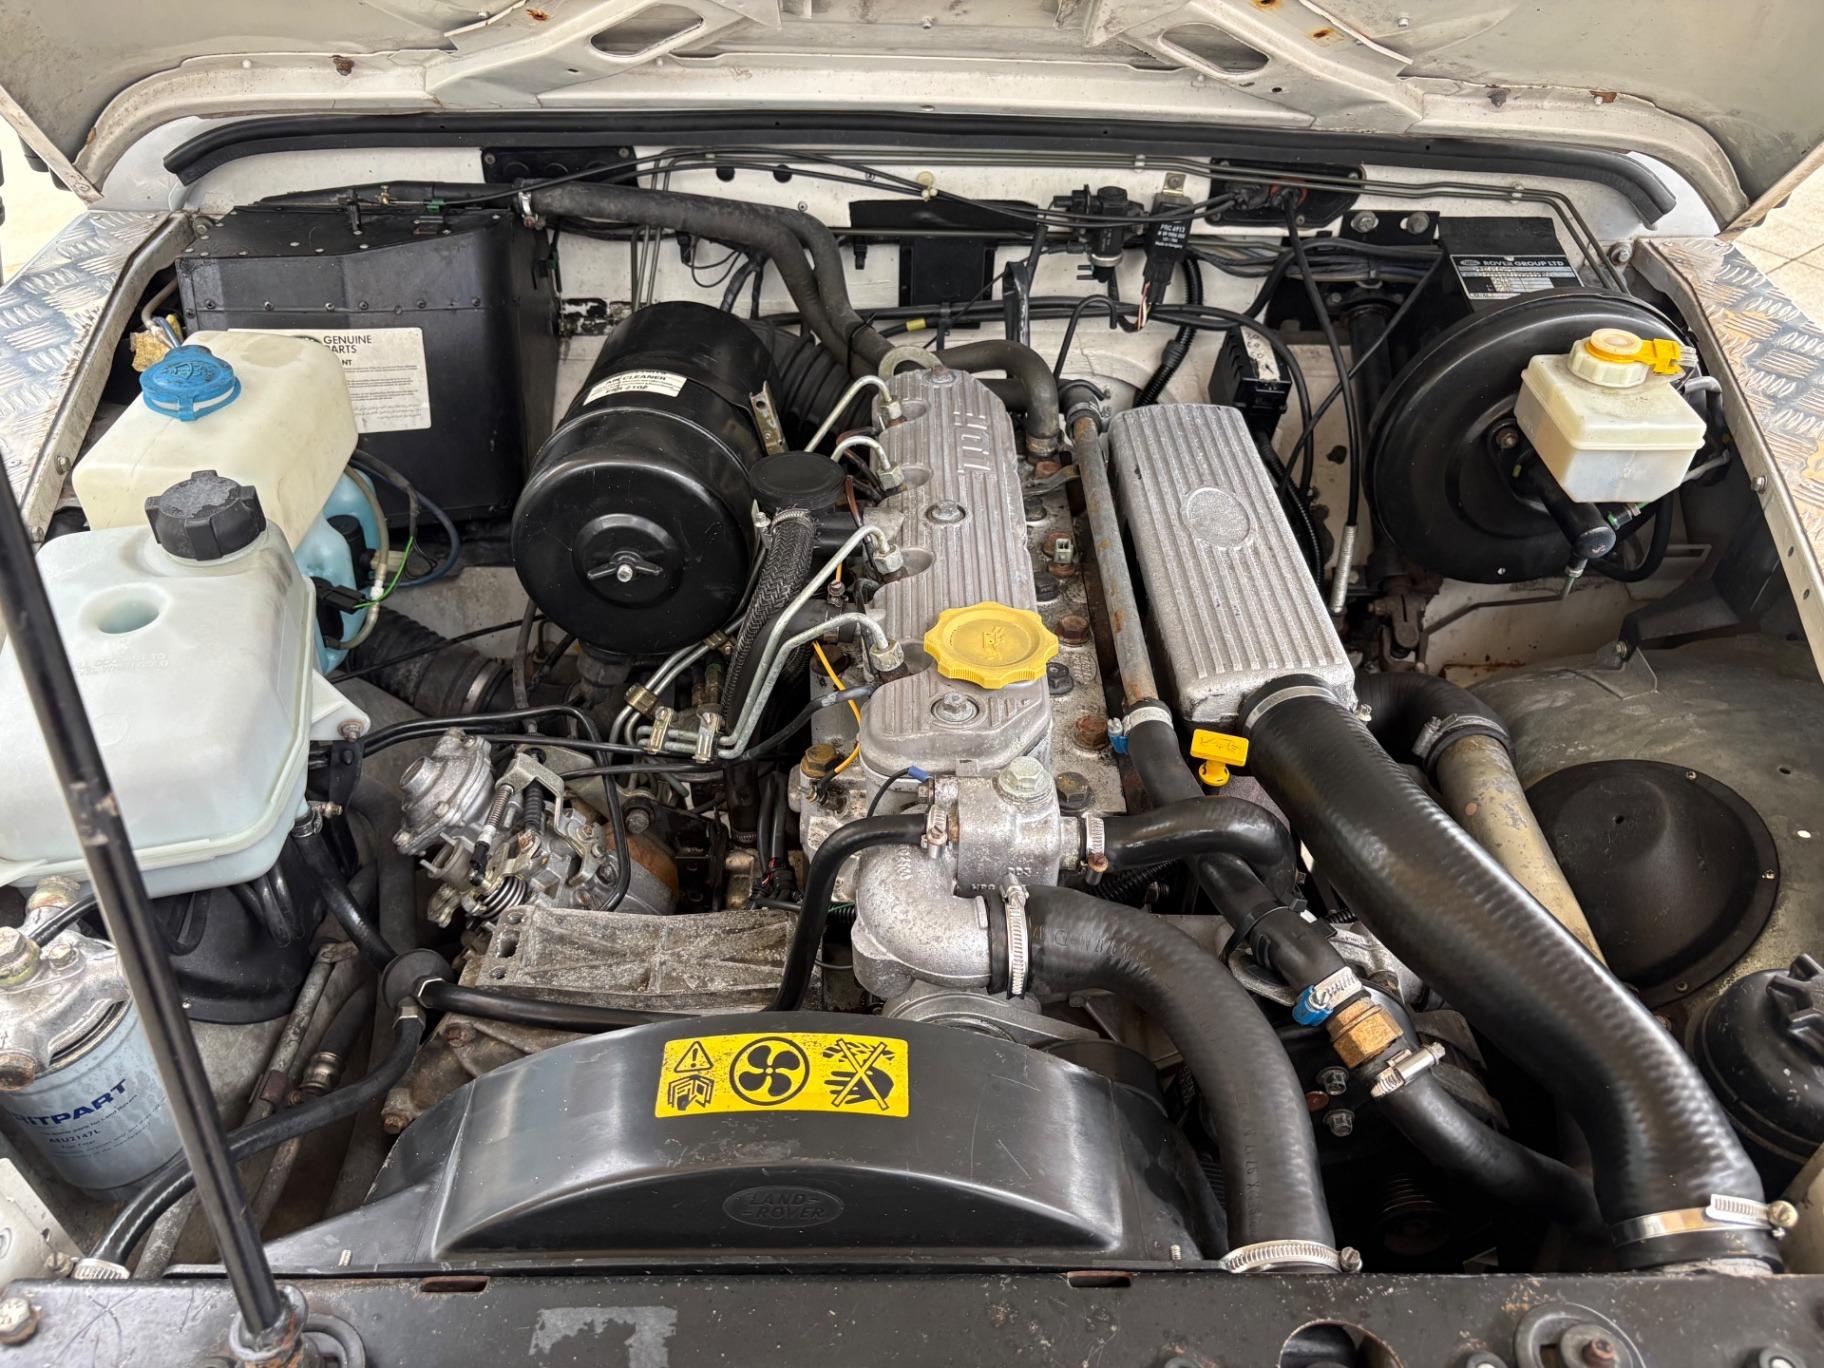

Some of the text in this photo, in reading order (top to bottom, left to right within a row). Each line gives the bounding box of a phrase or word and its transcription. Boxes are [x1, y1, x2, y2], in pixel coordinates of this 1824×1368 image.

[323, 335, 372, 345] GENUINE
[12, 1078, 127, 1127] RITPART
[751, 1193, 806, 1205] LAND
[756, 1206, 825, 1218] ROVER
